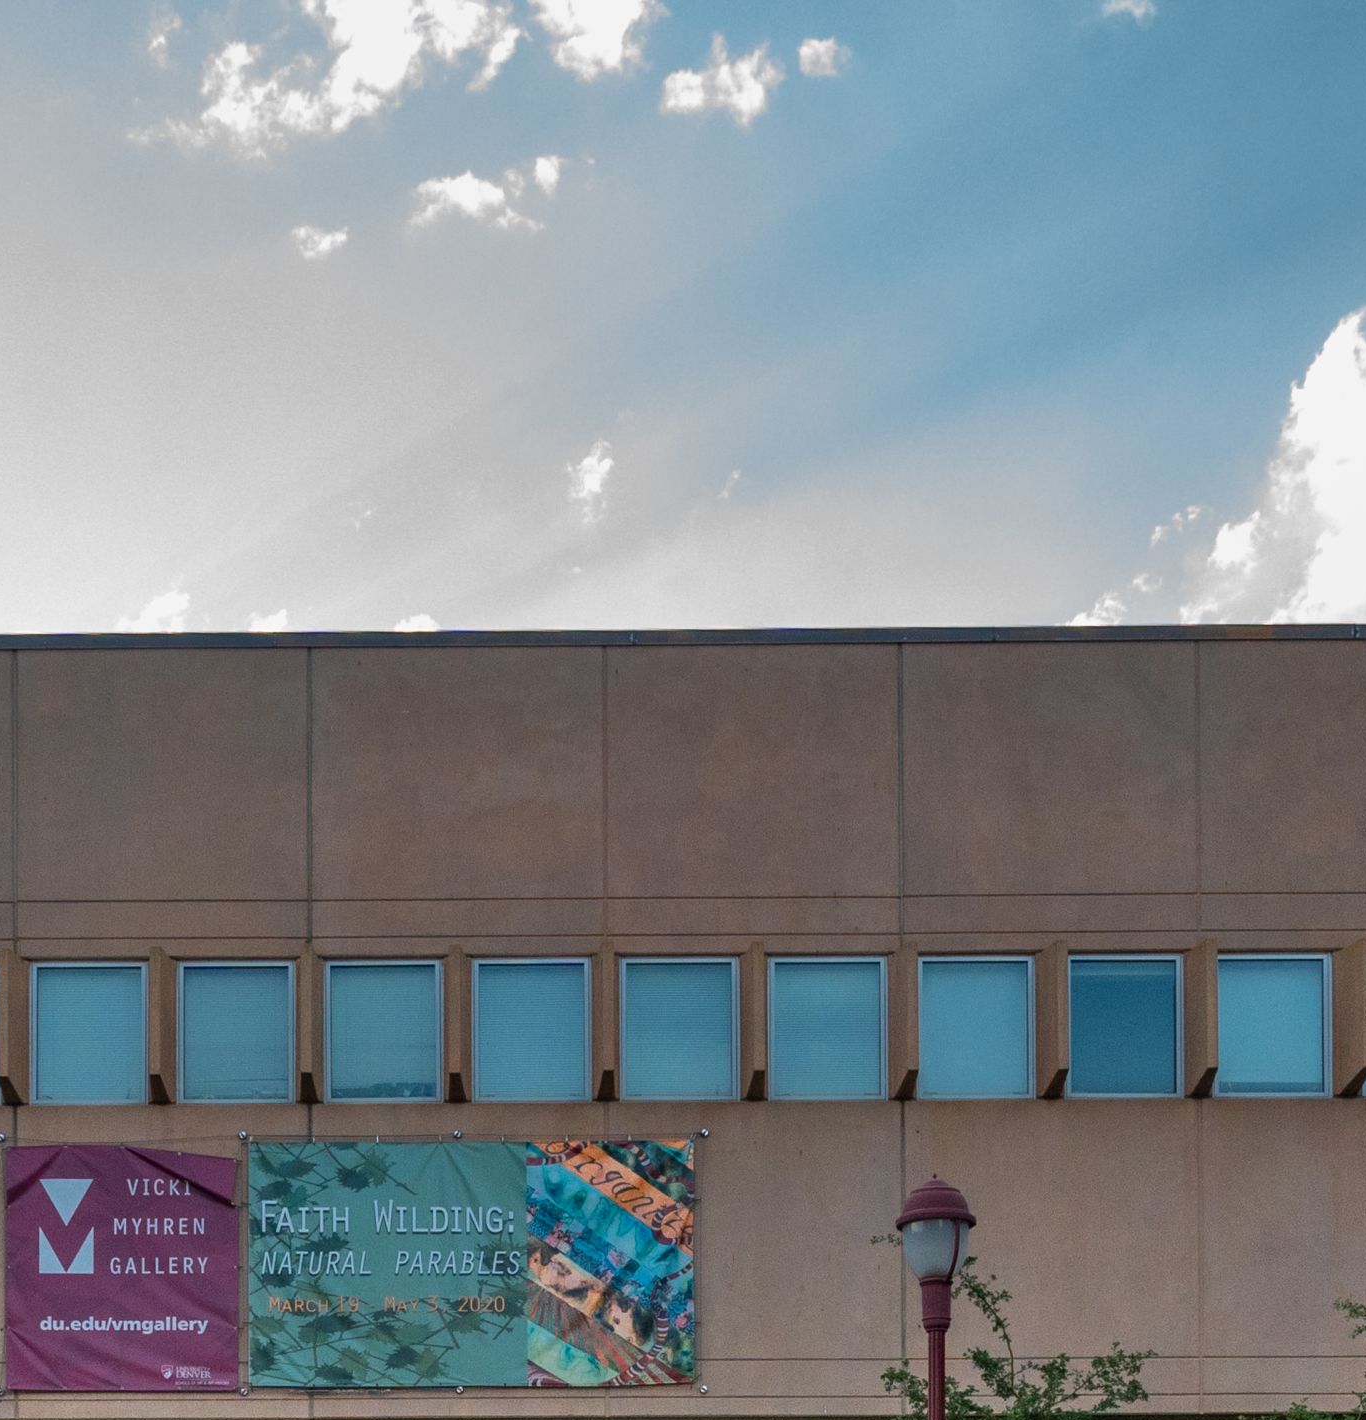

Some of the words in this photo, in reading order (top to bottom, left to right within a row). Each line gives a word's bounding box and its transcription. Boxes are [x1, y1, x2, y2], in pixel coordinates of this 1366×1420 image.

[127, 1178, 191, 1196] VICKI
[113, 1218, 205, 1235] MYHREN
[110, 1257, 208, 1274] GALLERY
[261, 1251, 372, 1275] NATURAL
[394, 1251, 521, 1275] PARABLES
[338, 1296, 359, 1312] 19
[458, 1296, 505, 1312] 2020
[40, 1316, 208, 1334] du.edu/vmgallery
